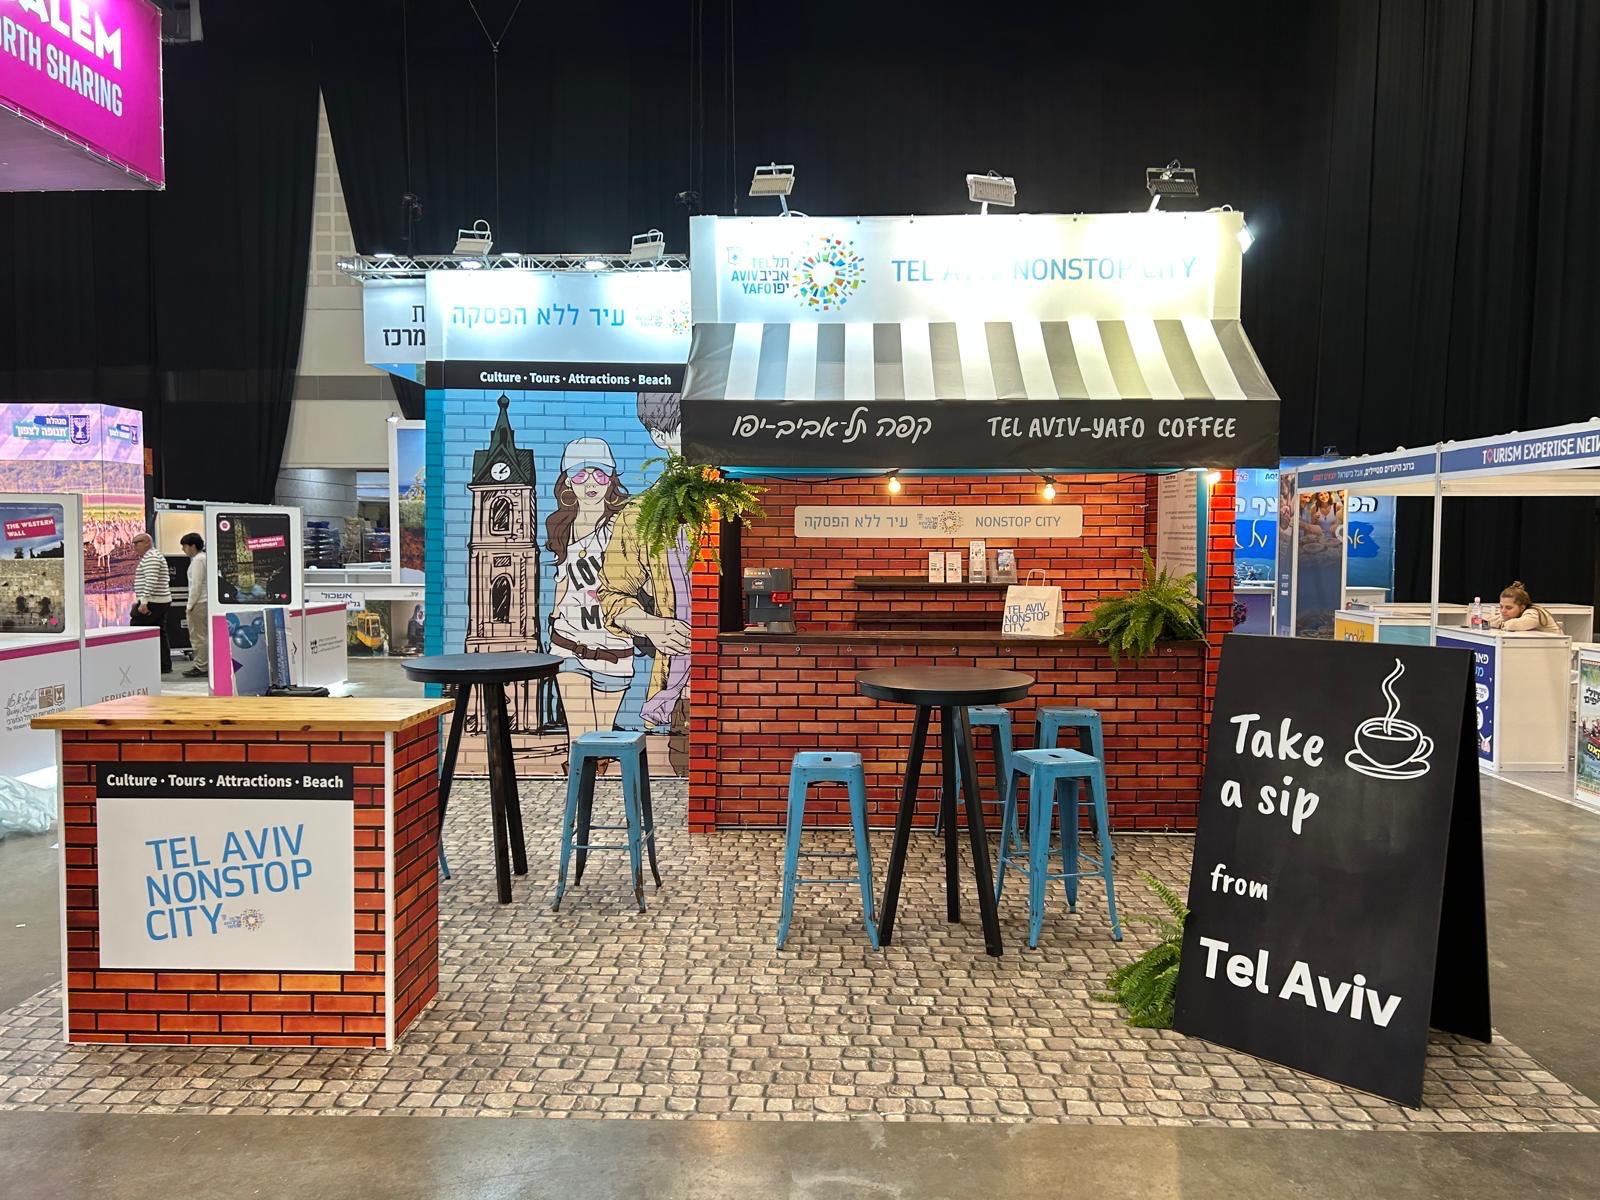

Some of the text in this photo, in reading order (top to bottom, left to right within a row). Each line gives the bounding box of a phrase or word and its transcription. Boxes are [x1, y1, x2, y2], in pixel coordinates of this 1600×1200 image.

[0, 15, 123, 117] RTH SHARING
[731, 269, 759, 282] AVIV
[759, 269, 790, 282] אביב
[891, 259, 935, 282] TEL
[742, 282, 772, 295] YAFO
[772, 282, 790, 295] יפו
[451, 304, 528, 331] הפסקה
[536, 302, 580, 327] ללא
[588, 307, 626, 327] עיר
[479, 371, 672, 386] Culture Tours Attractions Beach
[875, 415, 933, 444] קפה
[987, 416, 1237, 439] TEL AVIV-YAFO COFFEE
[1482, 445, 1522, 465] TOURISM
[1523, 438, 1575, 460] EXPERTISE
[6, 518, 54, 530] THE WESTERN
[803, 515, 850, 529] הפסקה
[854, 513, 882, 528] ללא
[885, 516, 909, 528] עיר
[975, 516, 1062, 528] NONSTOP CITY
[1004, 611, 1050, 624] NONSTOP
[1007, 602, 1047, 615] TEL AVIV
[1003, 623, 1026, 633] CITY
[1229, 712, 1325, 768] Take
[106, 773, 344, 789] Culture Tours Attractions Beach
[1220, 776, 1321, 836] a sip
[145, 823, 304, 871] TEL AVIV
[146, 858, 313, 907] NONSTOP
[1210, 863, 1269, 902] from
[145, 902, 224, 942] CITY
[1199, 936, 1403, 1028] Tel Aviv
